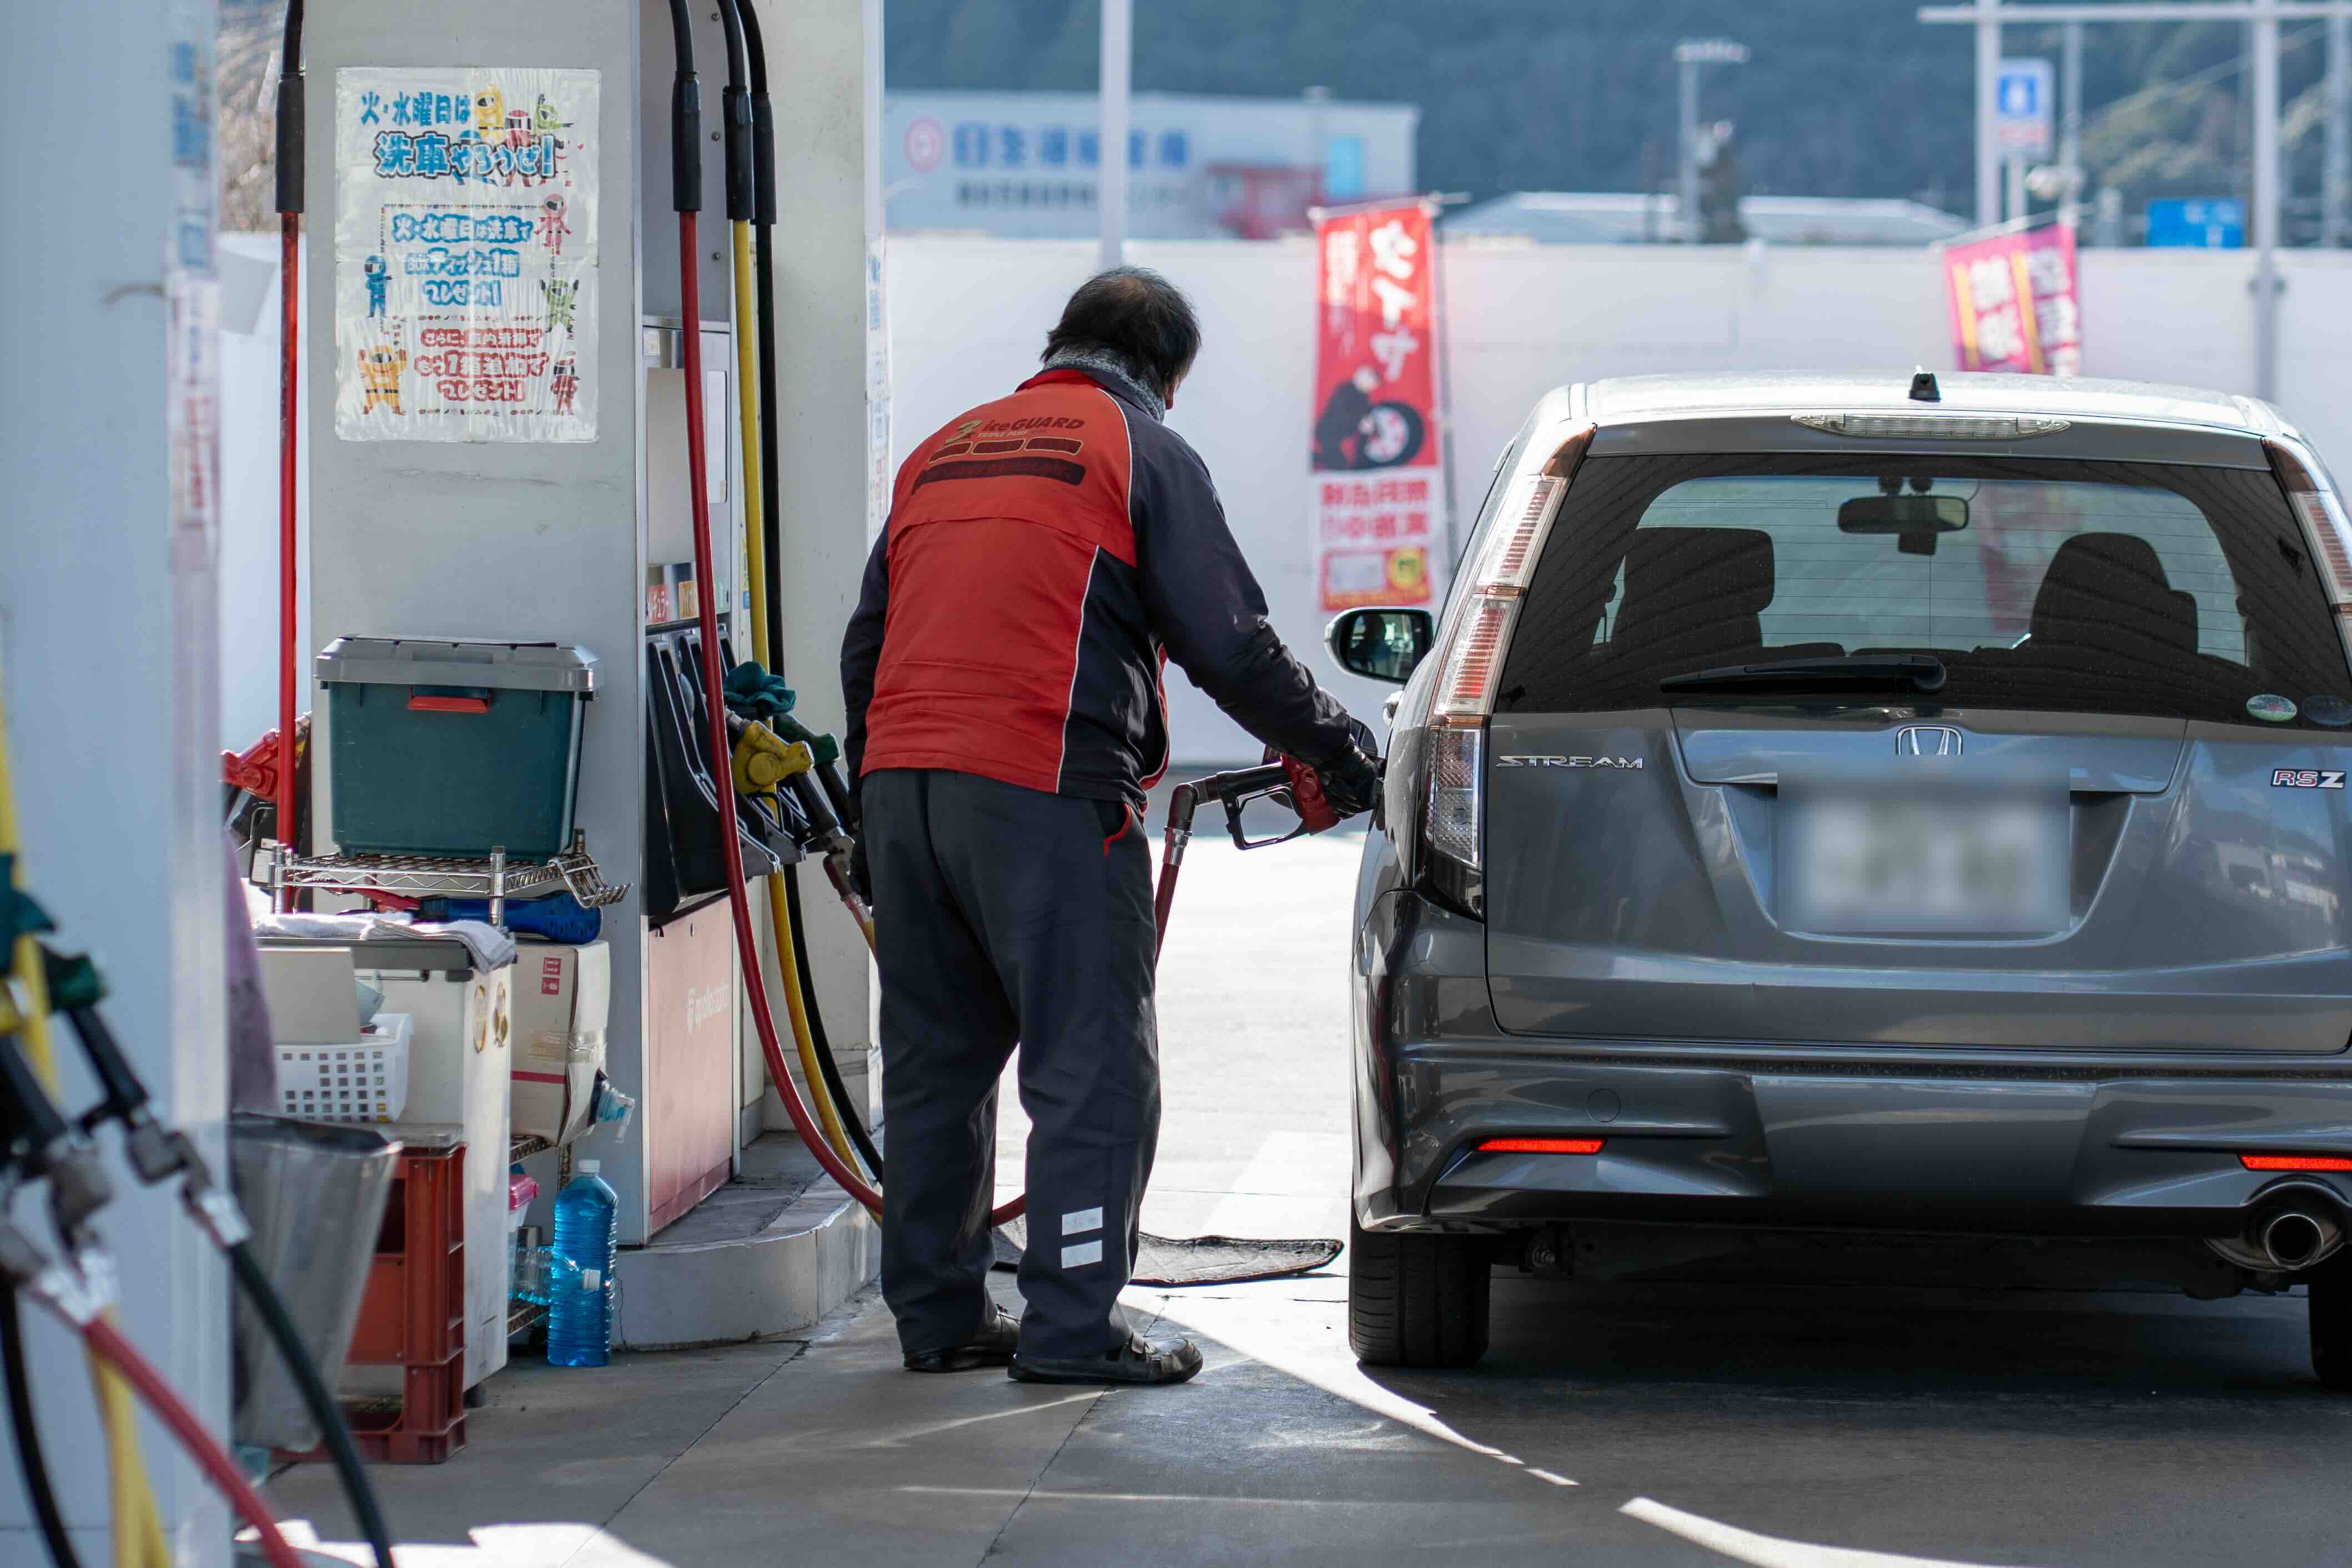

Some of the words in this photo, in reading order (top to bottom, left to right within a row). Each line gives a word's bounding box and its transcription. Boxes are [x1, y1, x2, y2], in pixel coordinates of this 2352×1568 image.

[360, 91, 471, 127] 火・水曜日は
[1496, 755, 1644, 770] STREAM
[2272, 770, 2346, 789] RSZ
